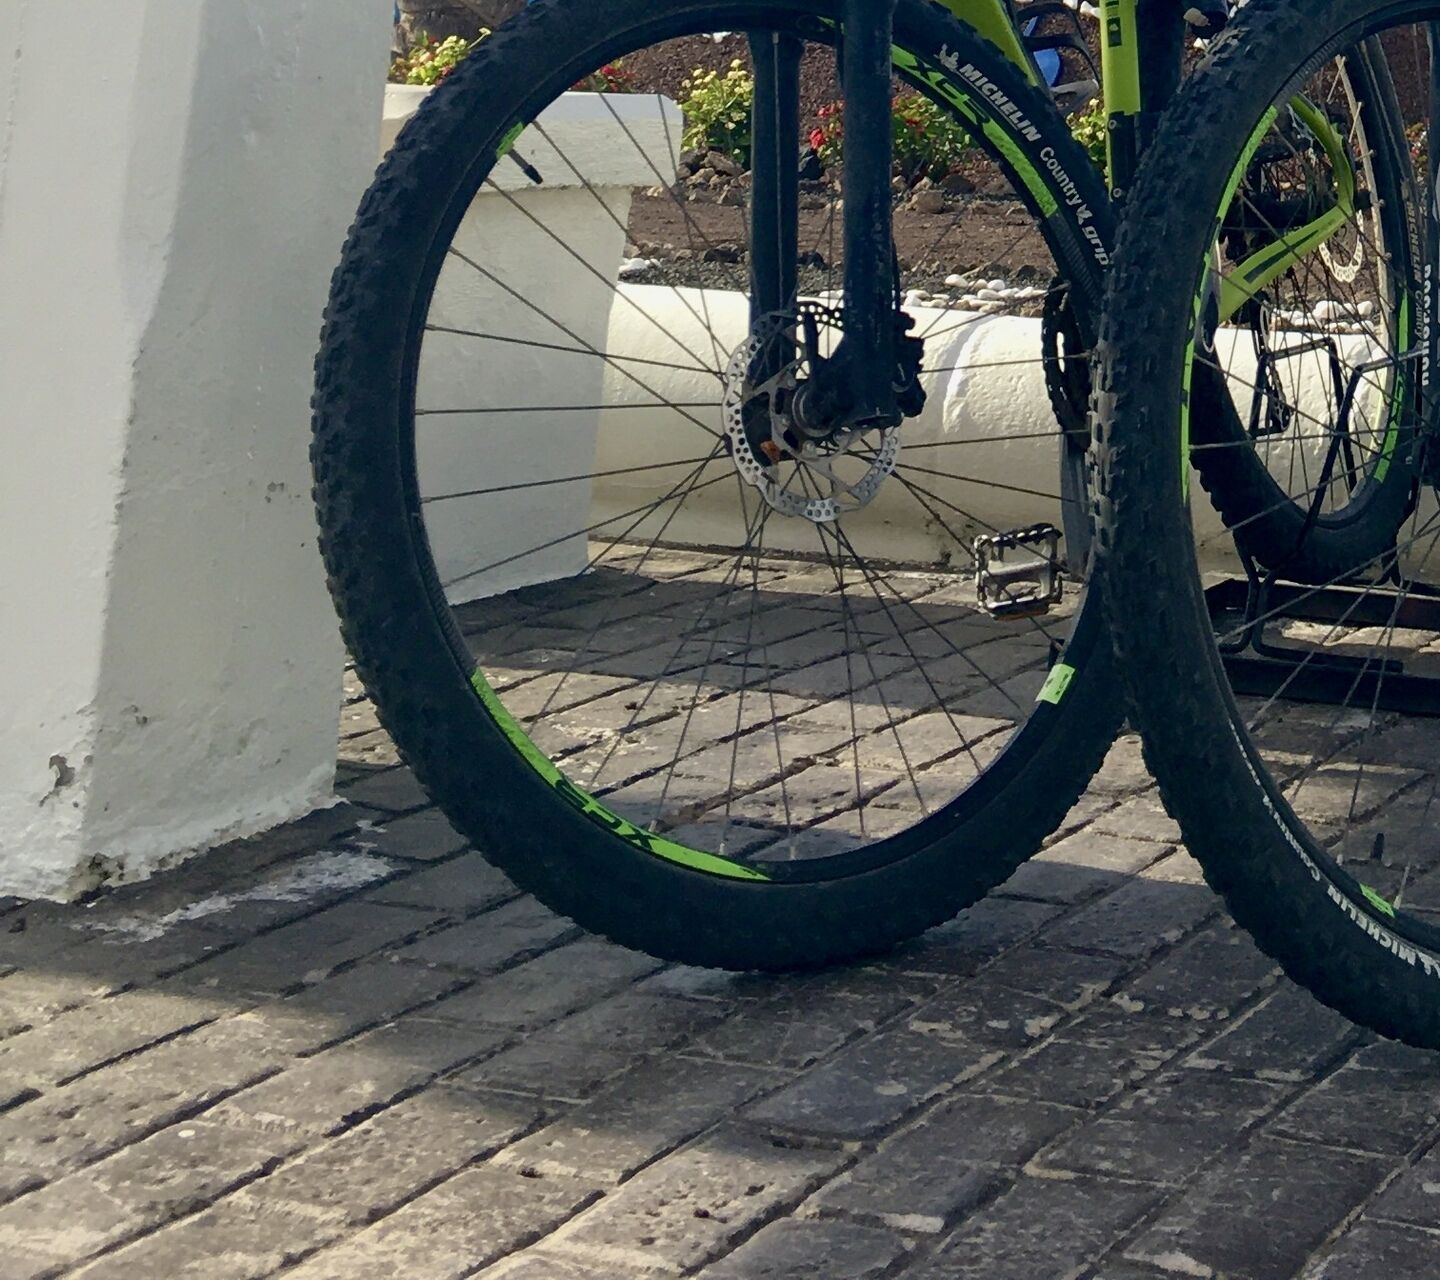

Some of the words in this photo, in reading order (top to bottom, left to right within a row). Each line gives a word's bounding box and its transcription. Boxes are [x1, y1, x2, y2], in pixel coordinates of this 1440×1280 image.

[959, 63, 1042, 142] MICHELIN
[1039, 146, 1083, 207] Country
[1406, 201, 1422, 284] MICHELIN
[1326, 884, 1417, 968] MICHELIN
